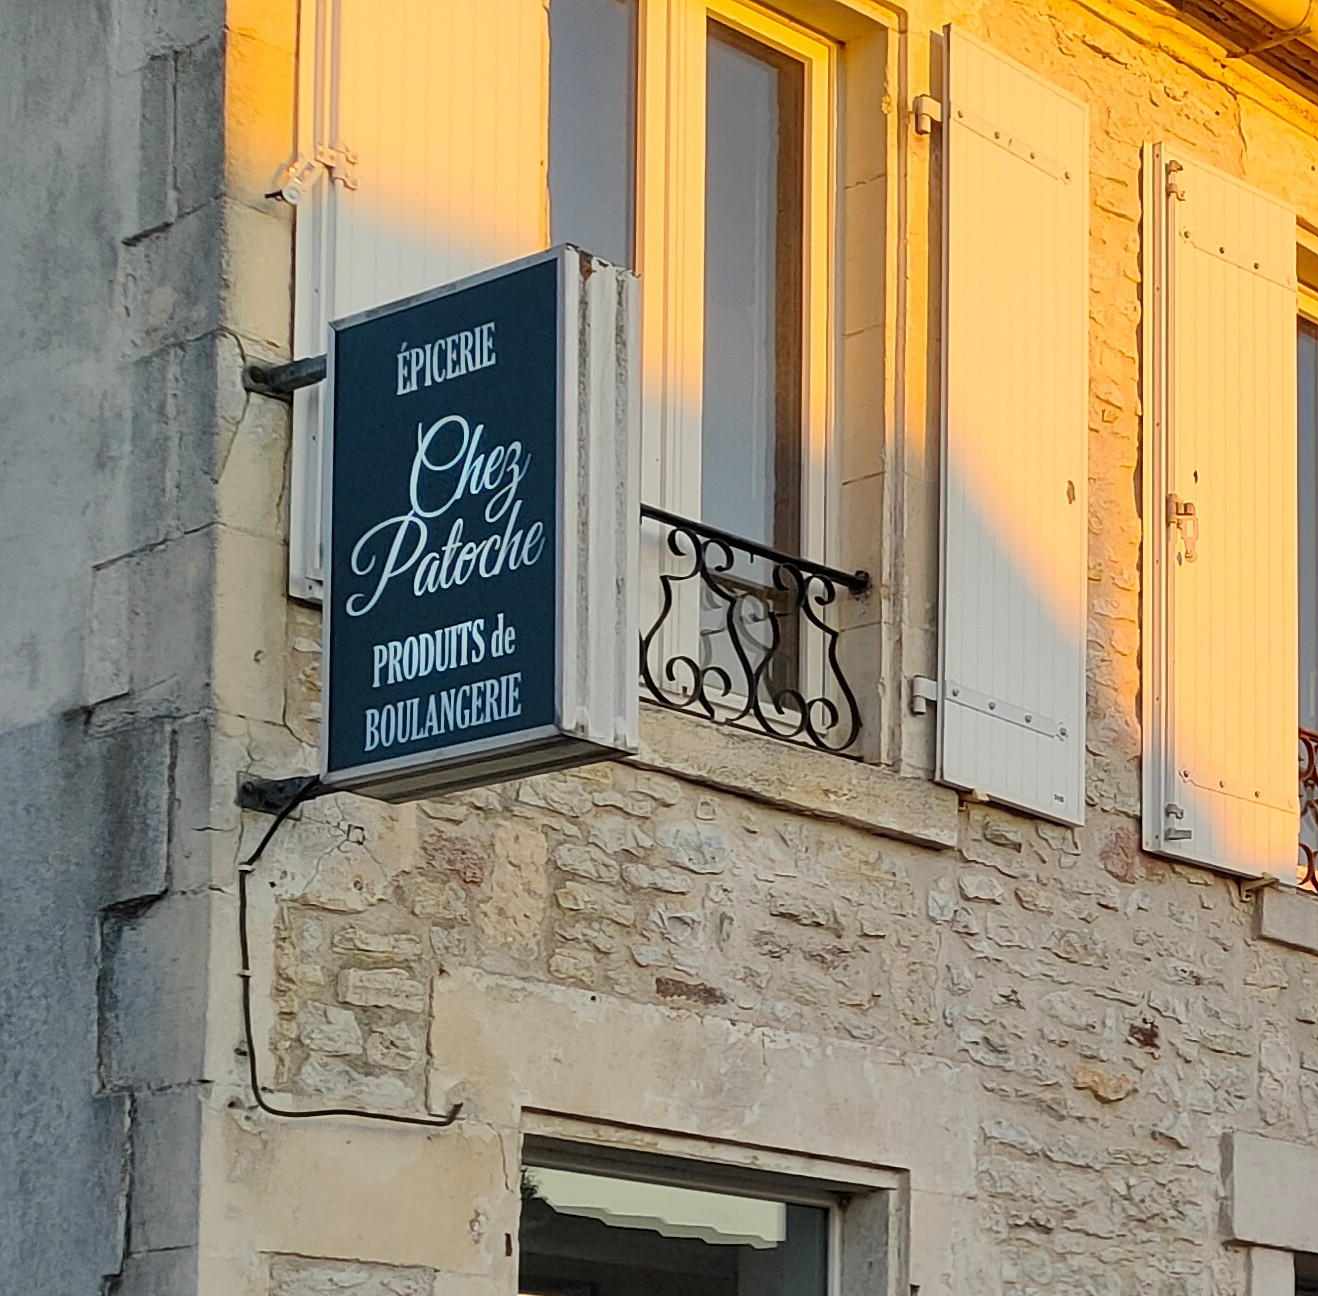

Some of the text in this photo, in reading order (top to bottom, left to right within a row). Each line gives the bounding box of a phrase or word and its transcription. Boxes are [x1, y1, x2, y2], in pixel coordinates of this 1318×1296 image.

[396, 321, 497, 396] ÉPICERIE
[409, 414, 531, 524] Chez
[345, 500, 546, 617] Patoche
[372, 613, 517, 689] PRODUITS de
[364, 672, 523, 753] BOULANGERIE
